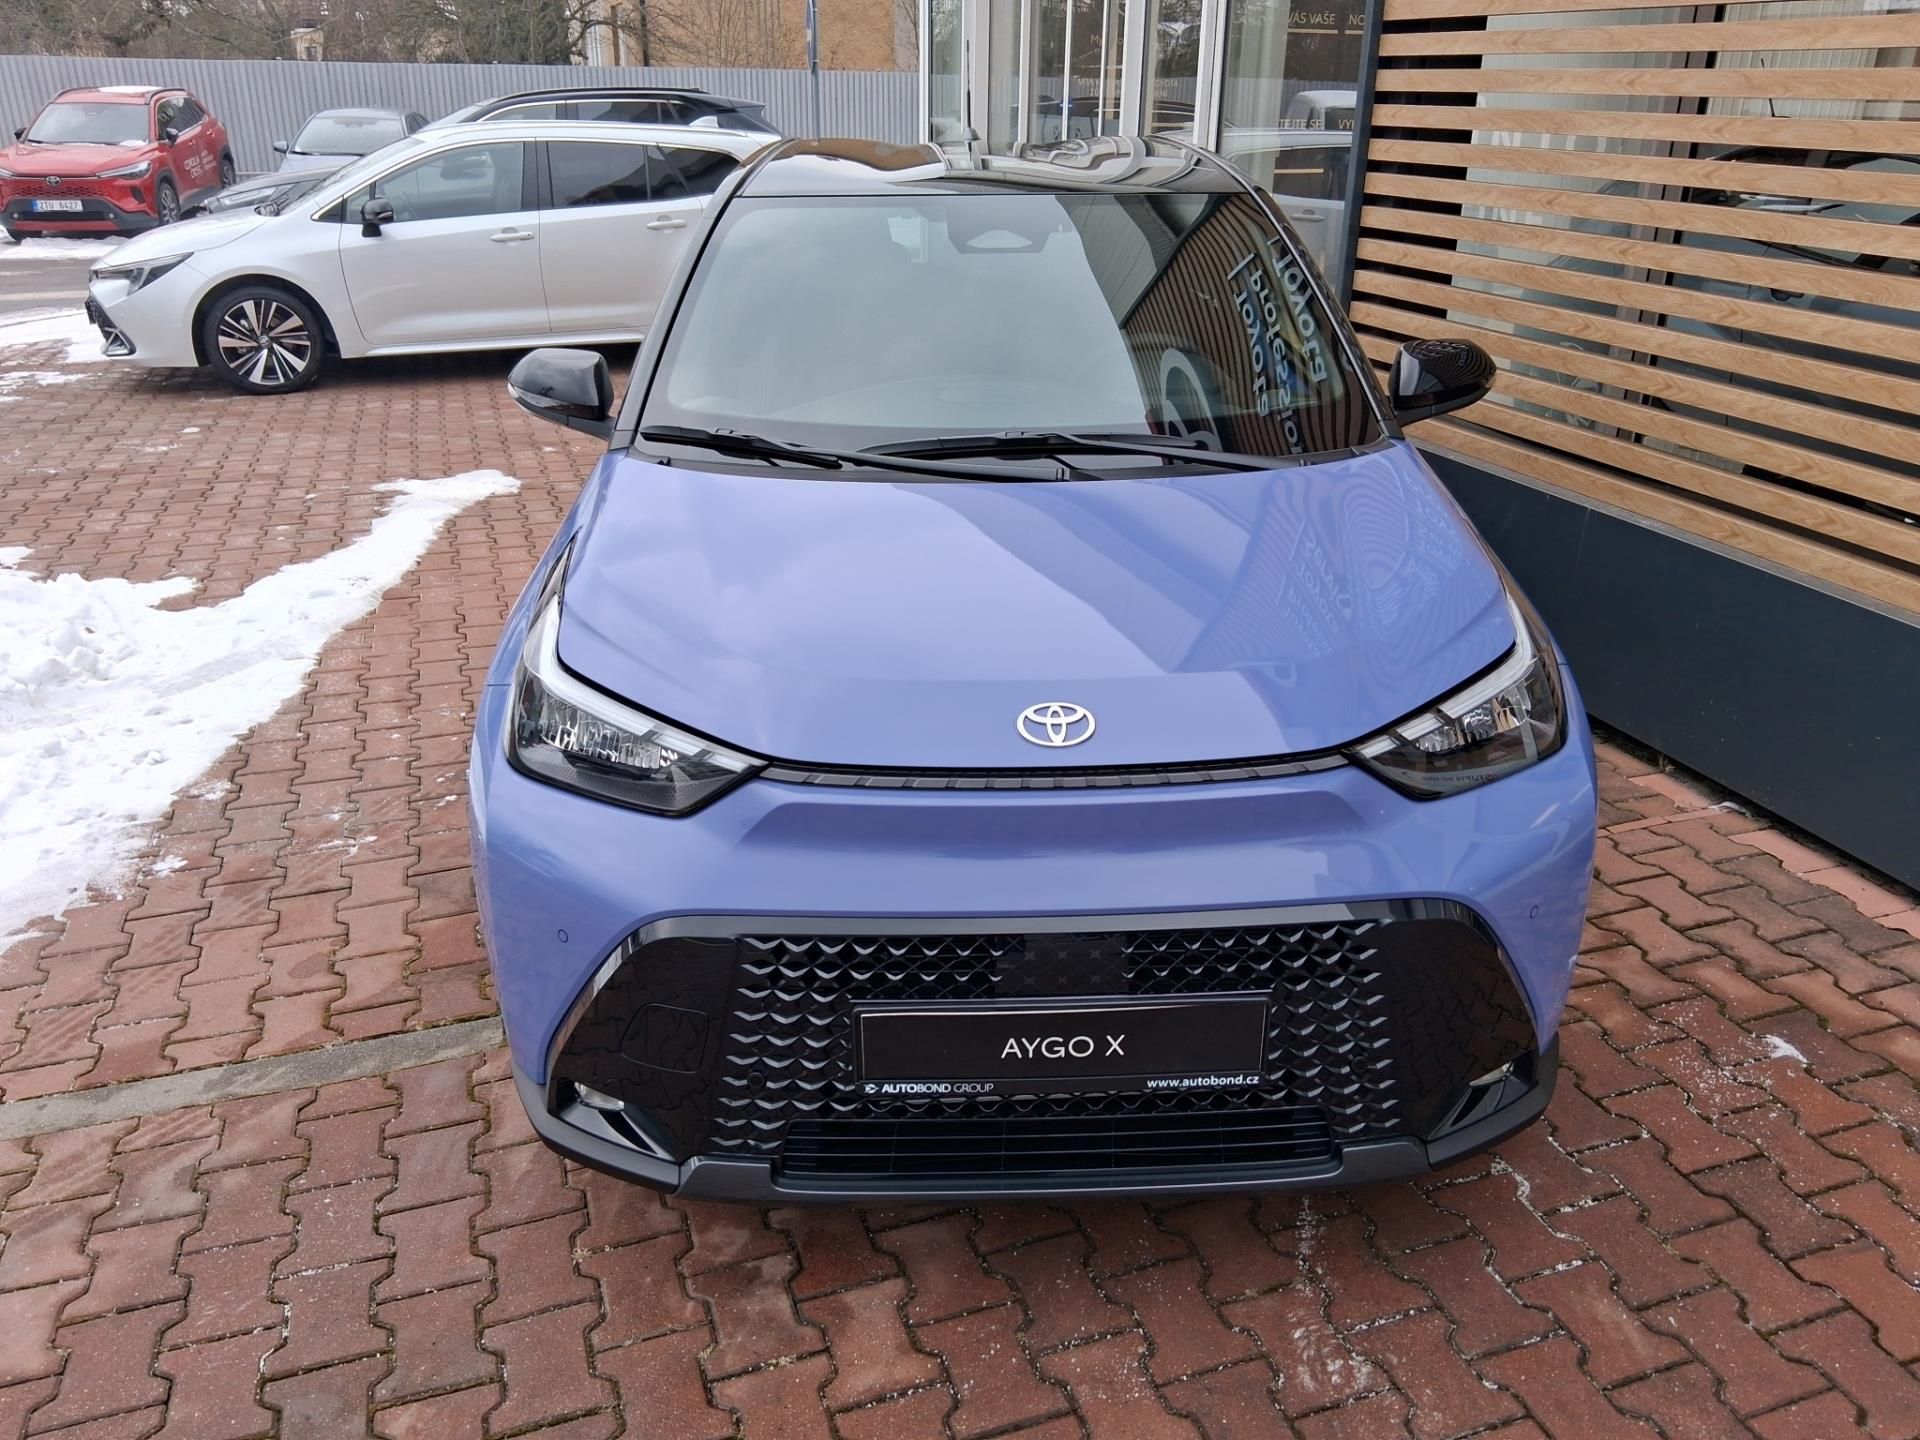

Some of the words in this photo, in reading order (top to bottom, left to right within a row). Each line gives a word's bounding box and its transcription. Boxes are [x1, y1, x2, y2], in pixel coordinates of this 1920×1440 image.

[1309, 10, 1336, 25] VAŠE
[1309, 119, 1323, 129] SE
[1001, 1035, 1094, 1059] AYGO
[1105, 1034, 1125, 1057] X
[1147, 1074, 1260, 1088] www.autobond.cz
[881, 1083, 951, 1094] AUTOBOND
[953, 1083, 994, 1093] GROUP
